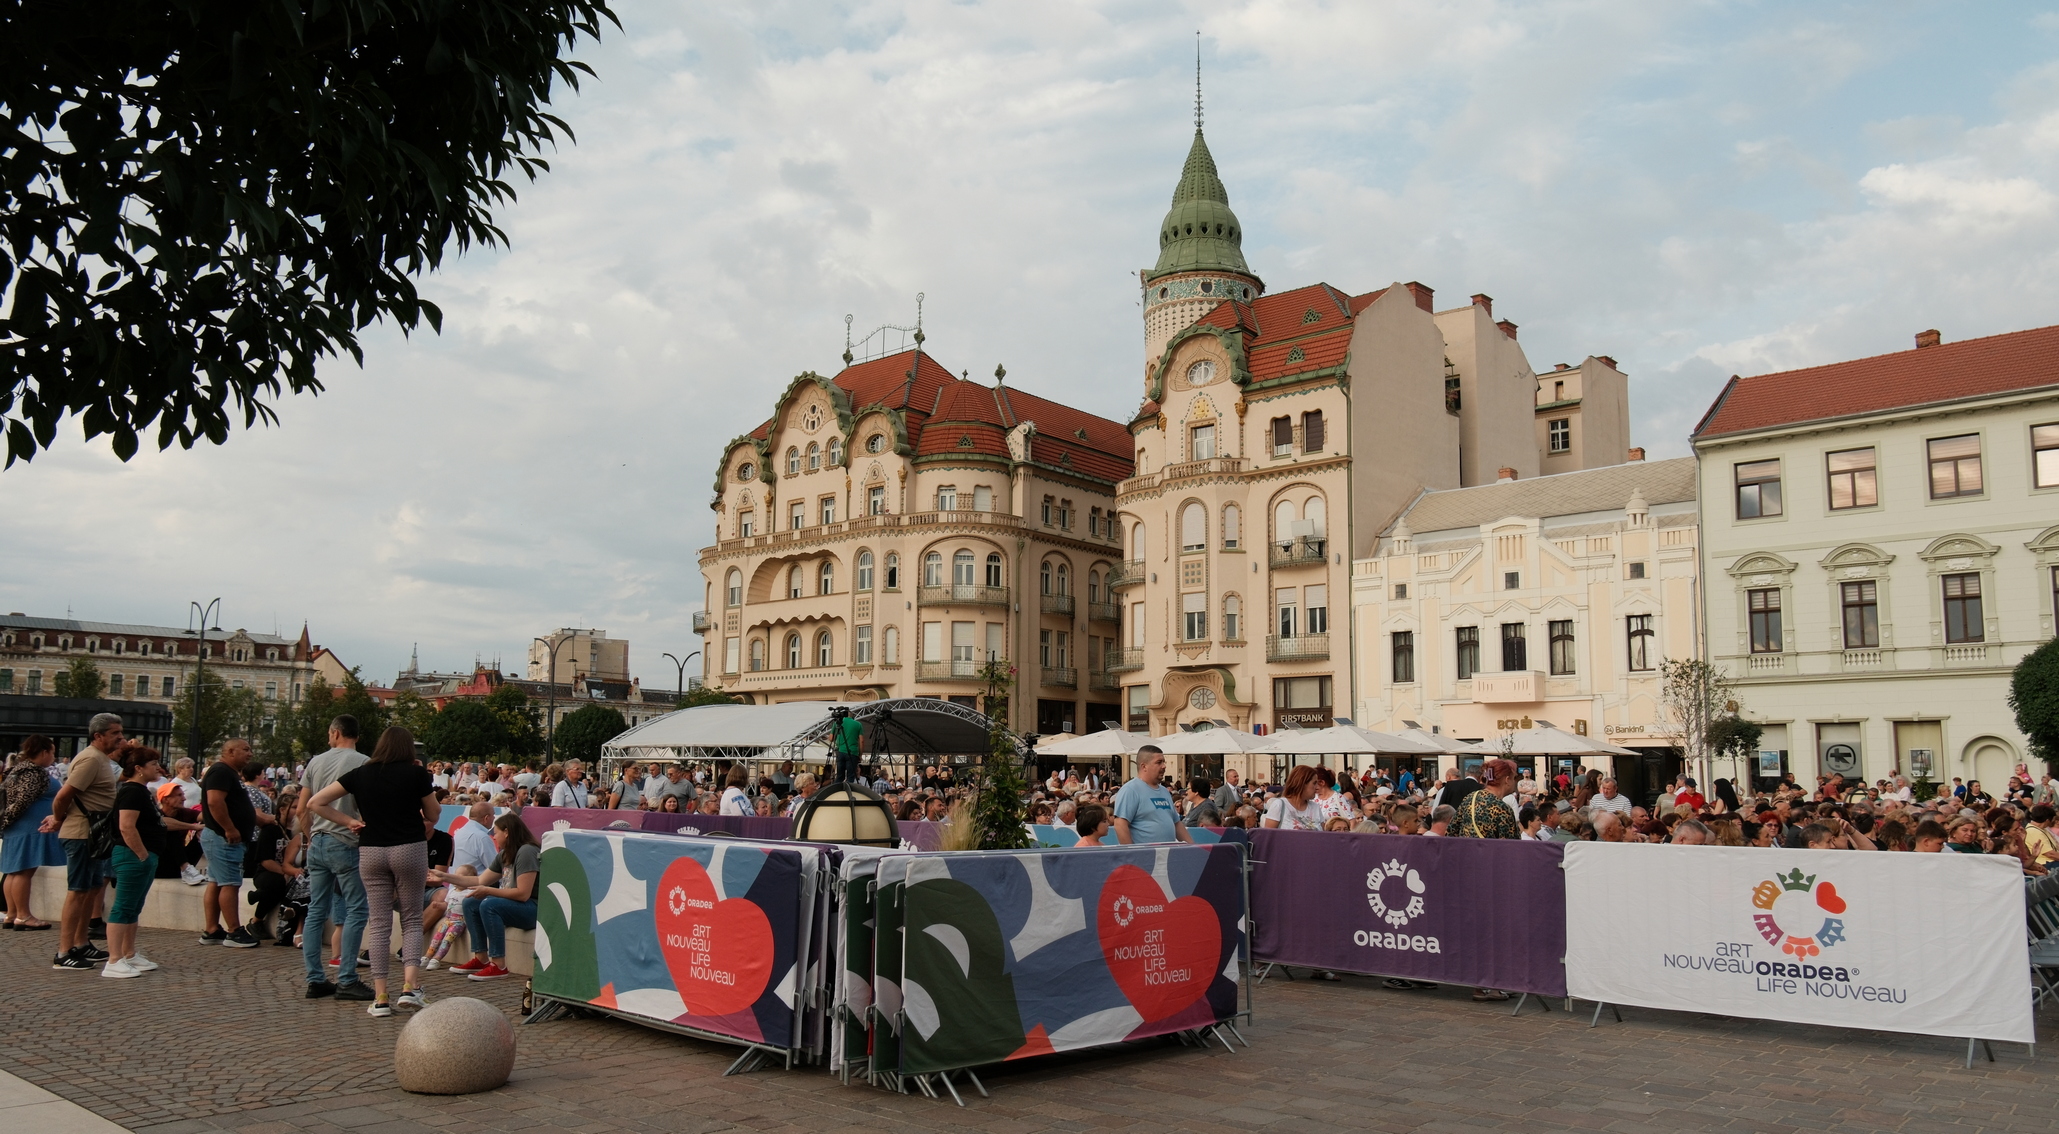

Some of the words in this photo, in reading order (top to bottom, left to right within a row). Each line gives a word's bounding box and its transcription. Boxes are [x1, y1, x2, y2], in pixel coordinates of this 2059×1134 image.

[1280, 713, 1324, 723] FIRSTBANK
[1497, 719, 1519, 730] BCR
[1615, 725, 1645, 734] Banking
